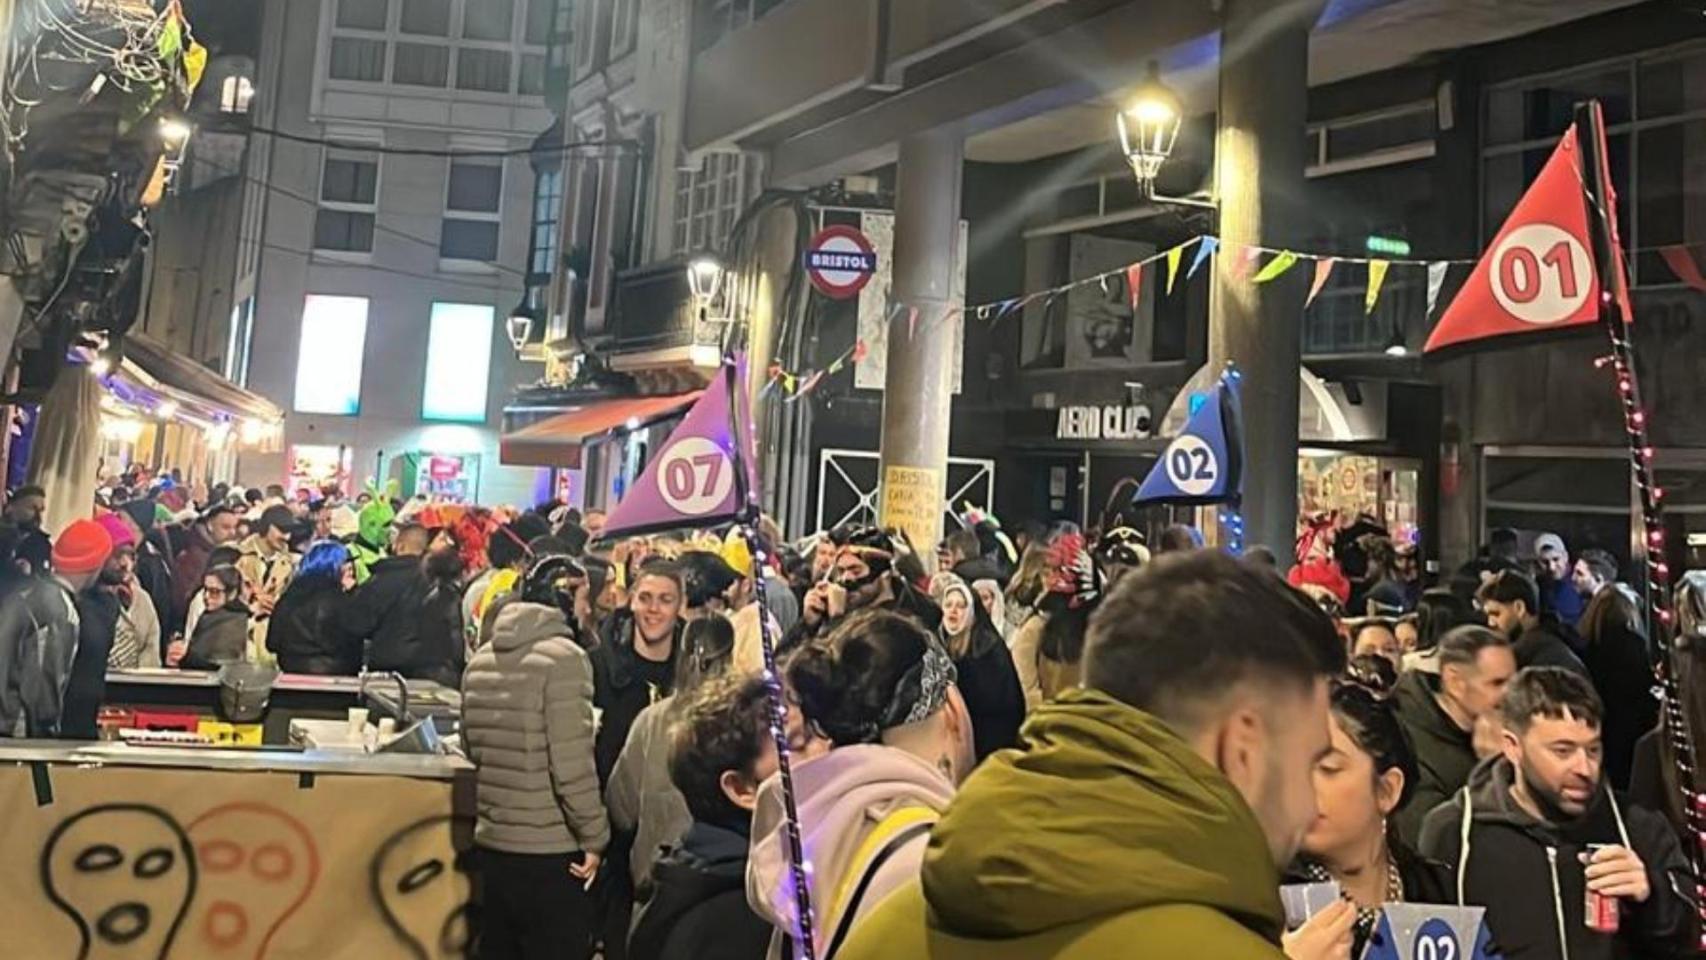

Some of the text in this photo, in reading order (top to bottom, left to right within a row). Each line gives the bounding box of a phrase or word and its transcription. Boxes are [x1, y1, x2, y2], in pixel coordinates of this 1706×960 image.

[812, 254, 869, 269] BRISTOL
[1499, 240, 1578, 304] 01
[1057, 406, 1100, 440] AERO
[665, 453, 723, 501] 07
[1172, 446, 1214, 482] 02
[1417, 934, 1455, 960] 02
